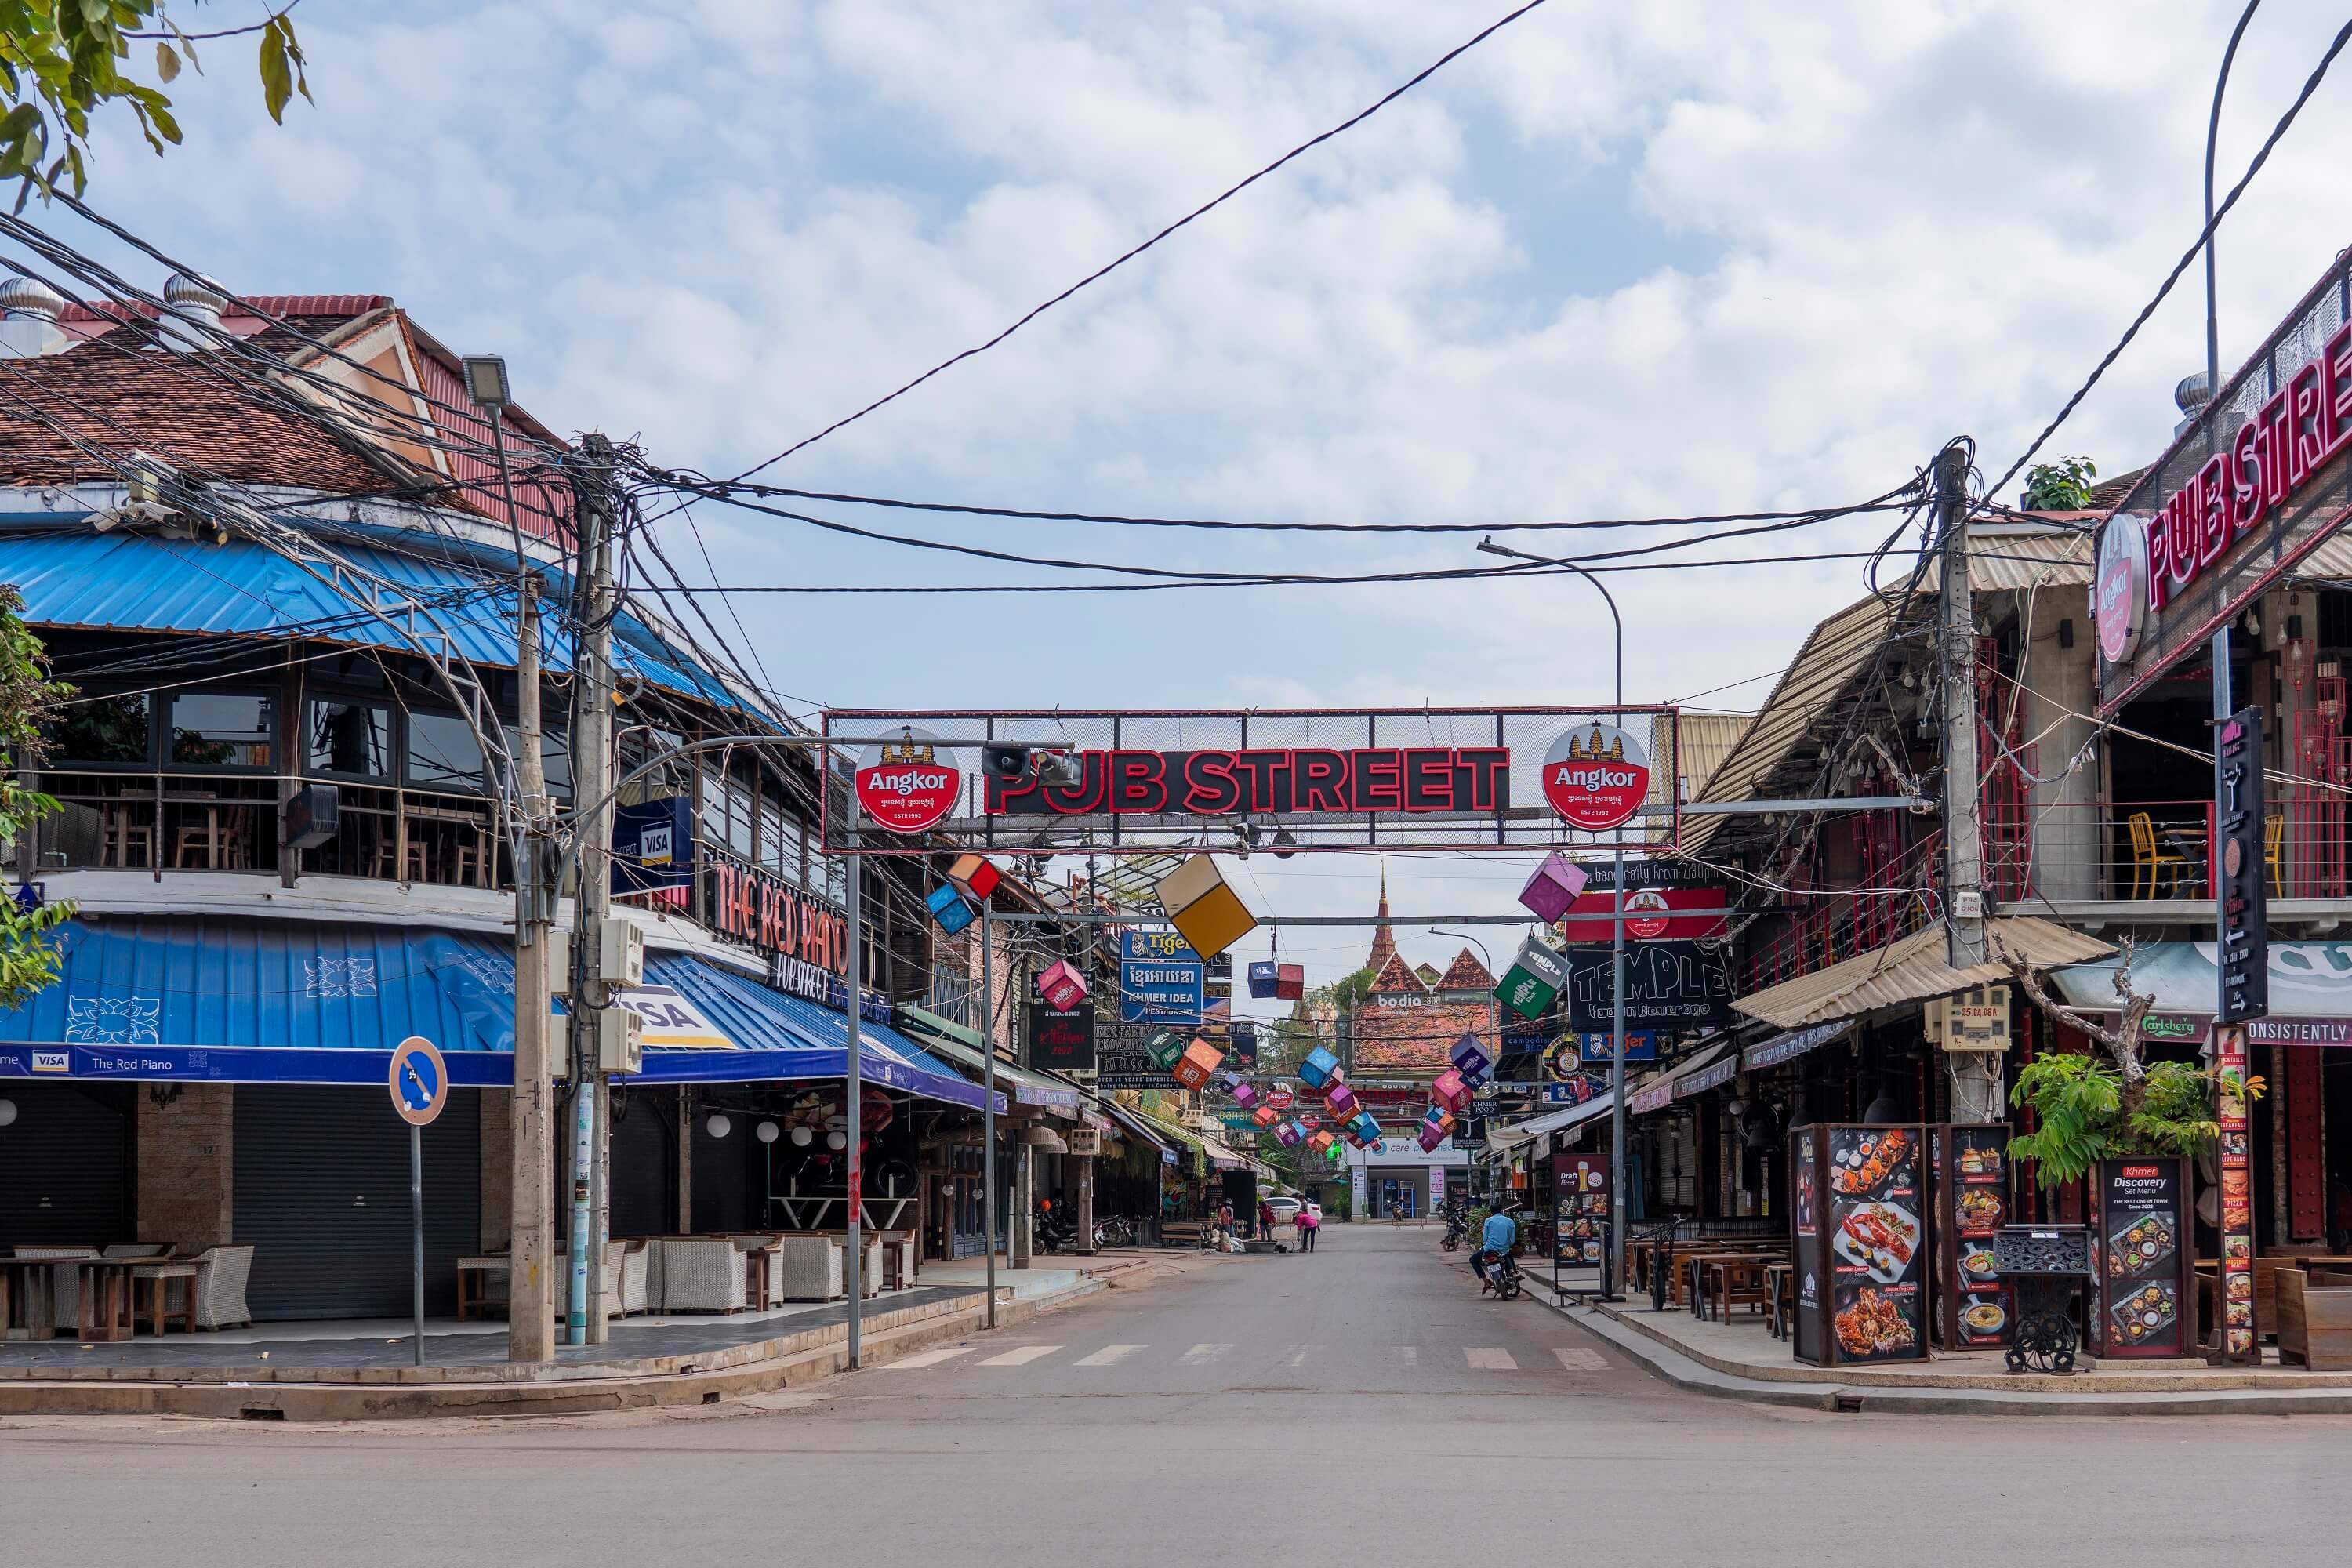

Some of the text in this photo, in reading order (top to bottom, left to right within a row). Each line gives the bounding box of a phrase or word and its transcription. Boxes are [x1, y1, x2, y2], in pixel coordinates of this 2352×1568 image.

[2147, 452, 2234, 613] PUB
[2100, 568, 2127, 614] Angkor
[868, 770, 948, 796] Angkor
[1184, 746, 1510, 815] STREET
[1555, 767, 1637, 792] Angkor
[644, 833, 669, 854] VISA
[713, 858, 848, 975] THE RED PIANO
[1528, 950, 1563, 976] TEMPLE
[1573, 945, 1726, 1002] TEMPLE
[776, 953, 795, 992] PUB
[796, 959, 829, 1002] STREET
[1053, 985, 1077, 1004] TEMPLE
[1128, 993, 1194, 1004] KHMER IDEA
[1378, 993, 1421, 1007] bodia
[1512, 978, 1537, 1007] TEMPLE
[2141, 1015, 2195, 1037] Carlsberg
[2249, 1022, 2347, 1041] ONSISTENTLY
[38, 1055, 64, 1066] VISA
[92, 1058, 172, 1070] The Red Piano
[1588, 1177, 1601, 1185] 0.50
[2126, 1167, 2157, 1176] Khmer
[2114, 1178, 2167, 1189] Discovery
